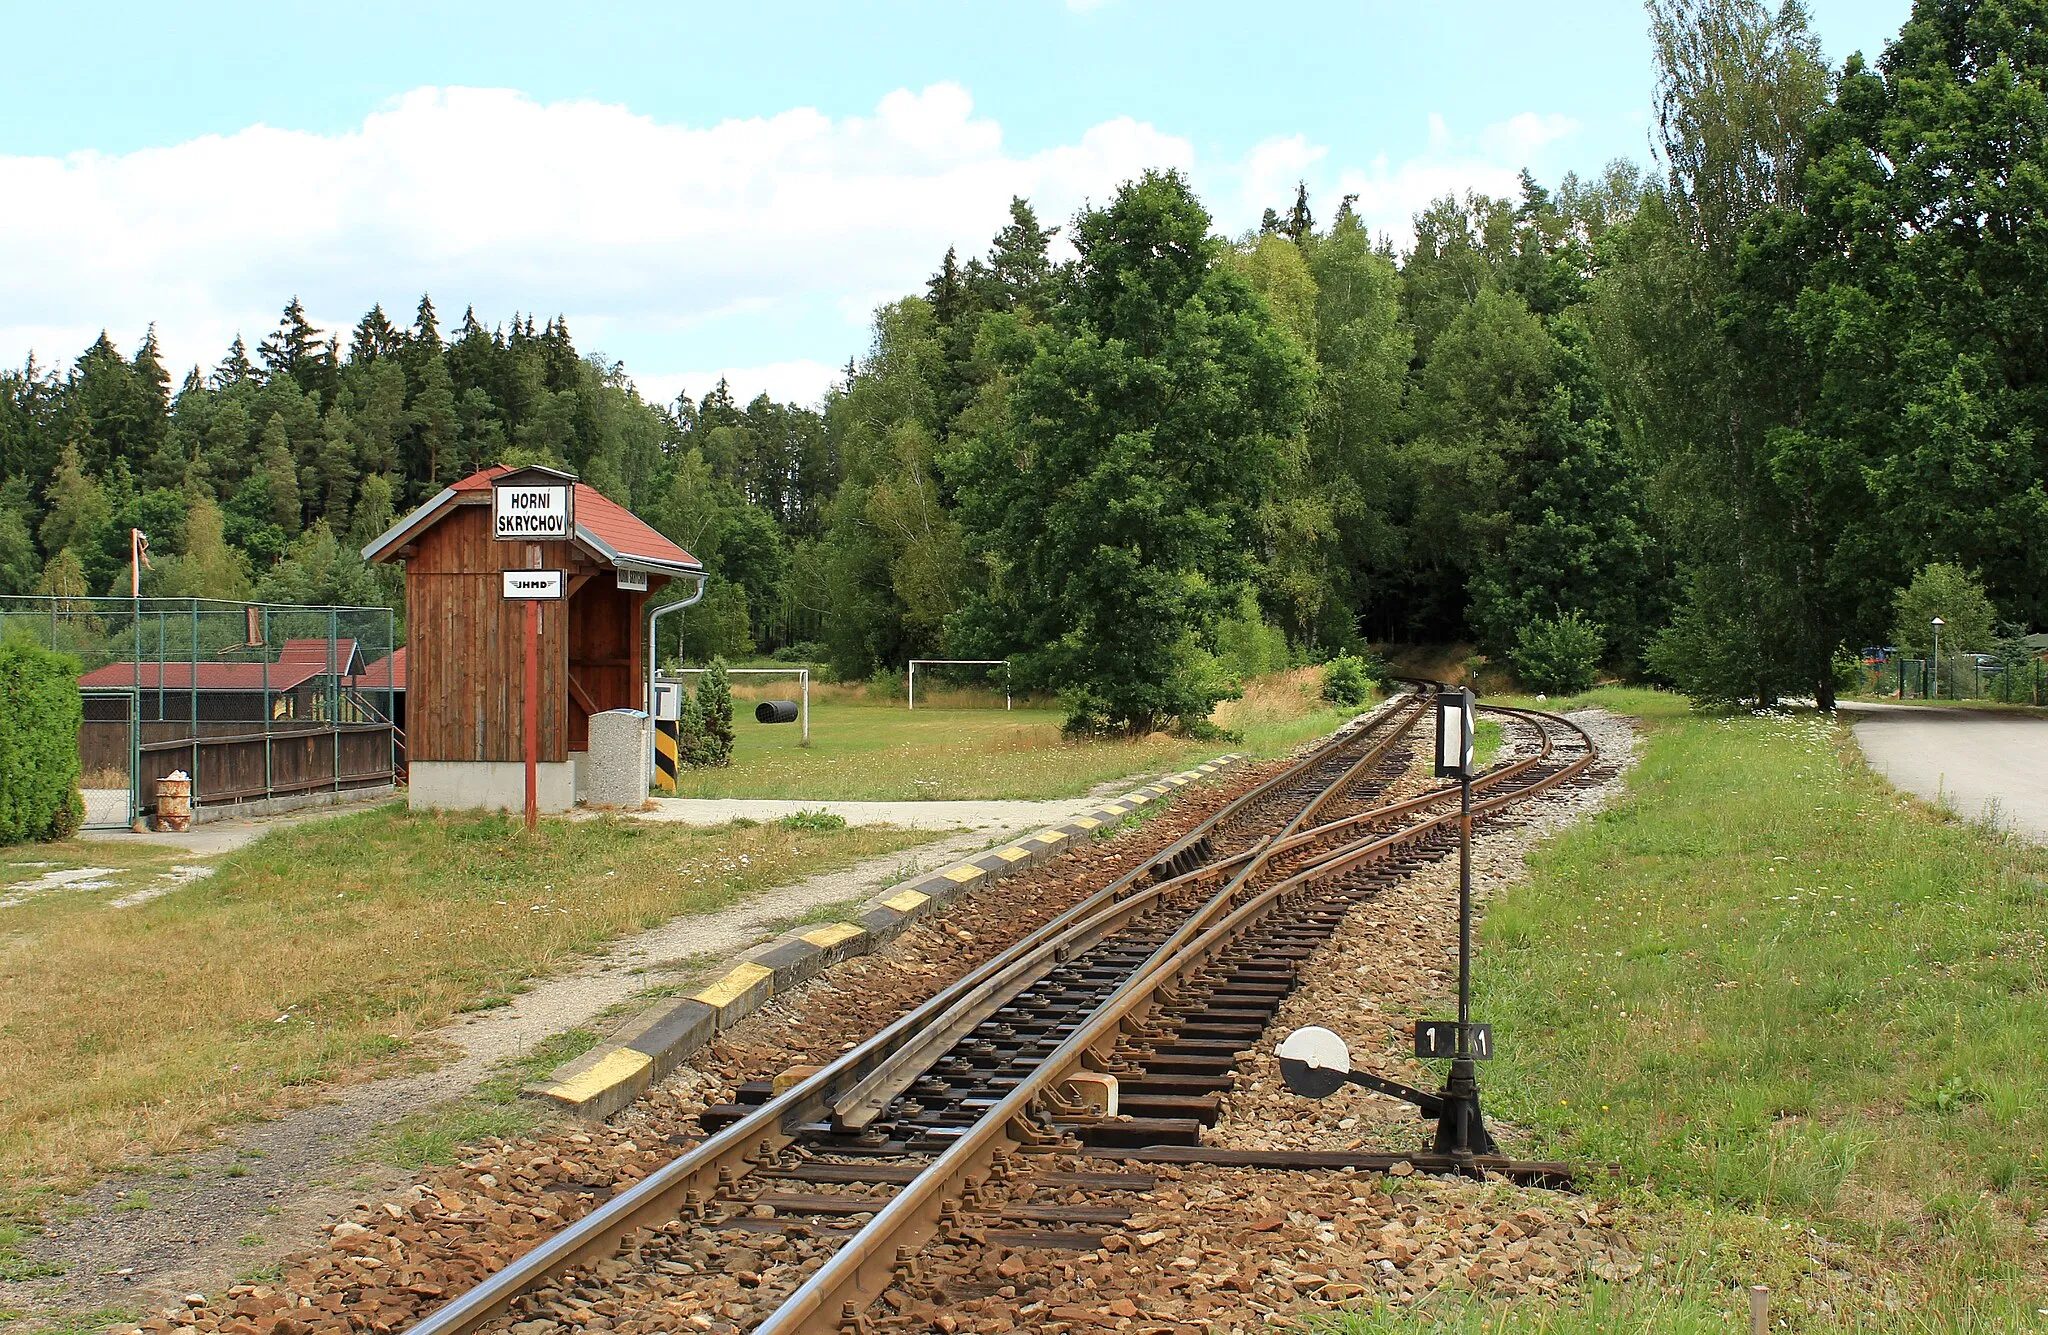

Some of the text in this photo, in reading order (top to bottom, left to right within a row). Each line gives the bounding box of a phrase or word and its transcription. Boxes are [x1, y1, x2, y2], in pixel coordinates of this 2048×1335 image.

[511, 488, 550, 509] HORNÍ
[499, 510, 563, 531] SKRÝCHOV
[1426, 1027, 1436, 1052] 1
[1478, 1029, 1487, 1056] 1
